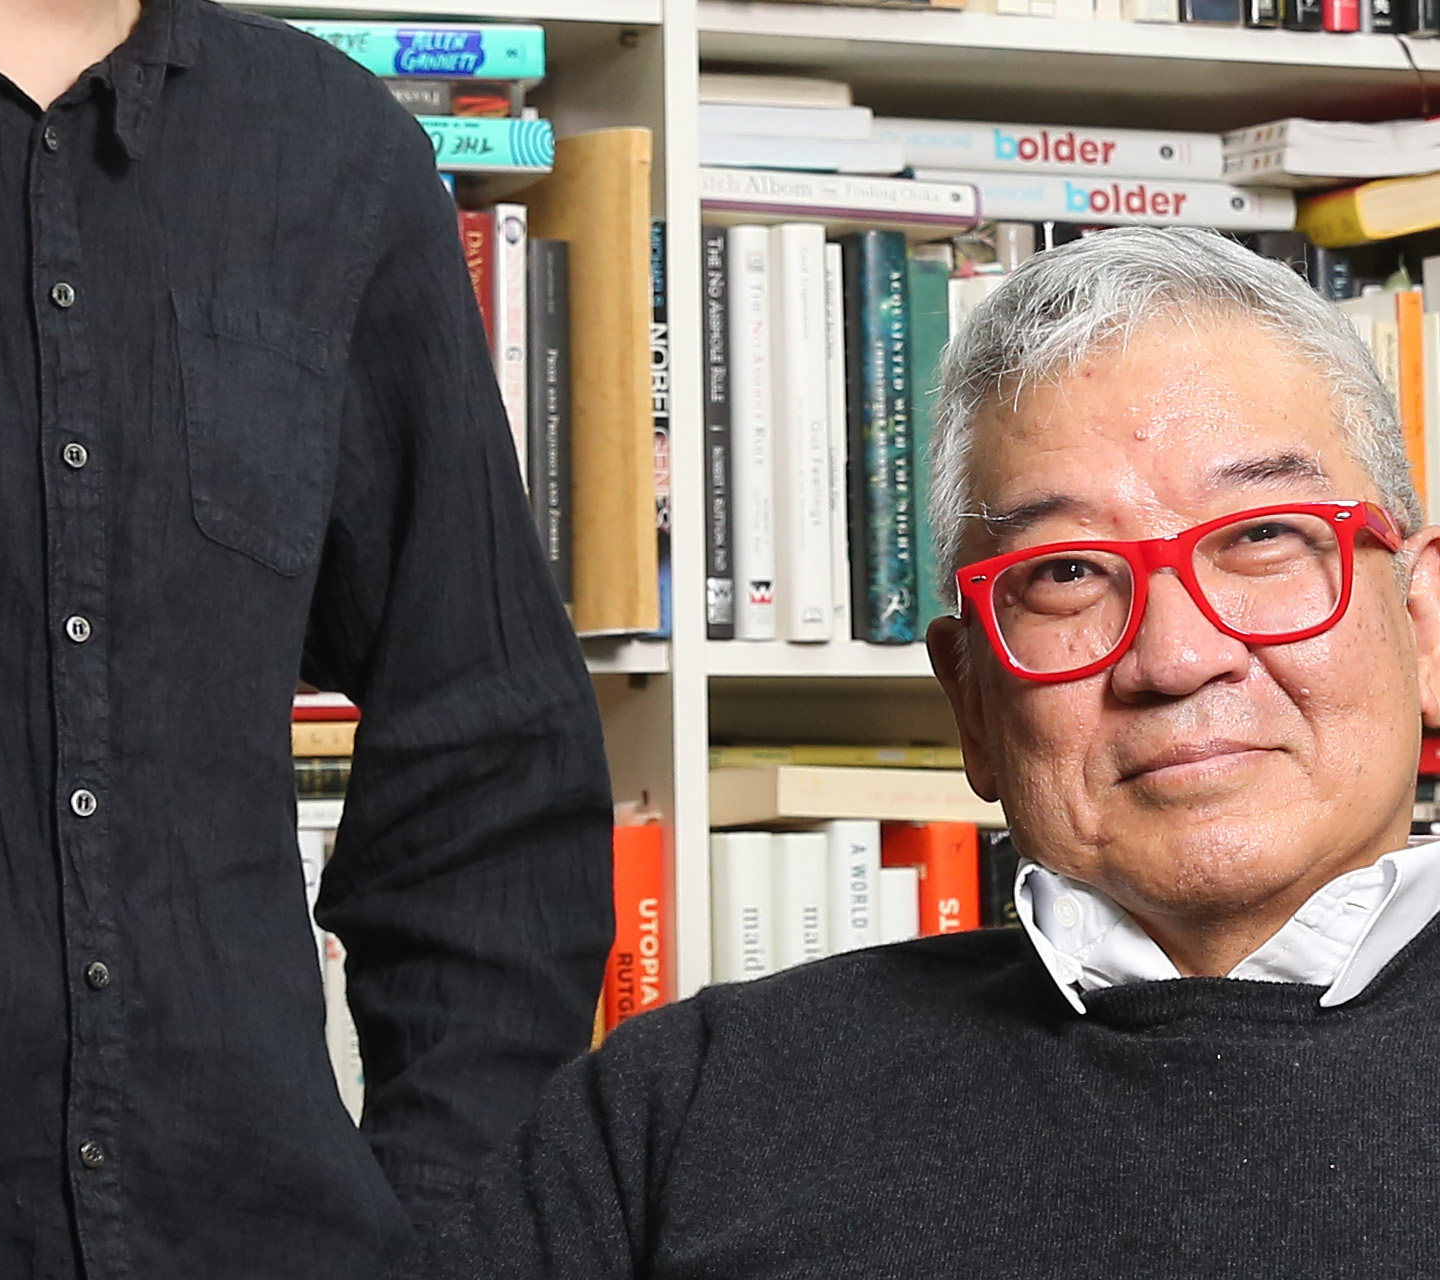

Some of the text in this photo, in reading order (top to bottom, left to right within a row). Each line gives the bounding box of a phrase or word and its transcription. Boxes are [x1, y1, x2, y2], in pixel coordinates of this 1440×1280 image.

[412, 30, 467, 52] ALLEN
[993, 124, 1116, 167] bolder
[743, 176, 813, 200] Albom
[1064, 178, 1188, 218] bolder
[707, 238, 726, 403] THE NO RULE
[889, 271, 910, 561] ACQUAINTED WITH THE NIGHT
[850, 844, 870, 929] A WORLD
[638, 898, 658, 1005] UTOPIA
